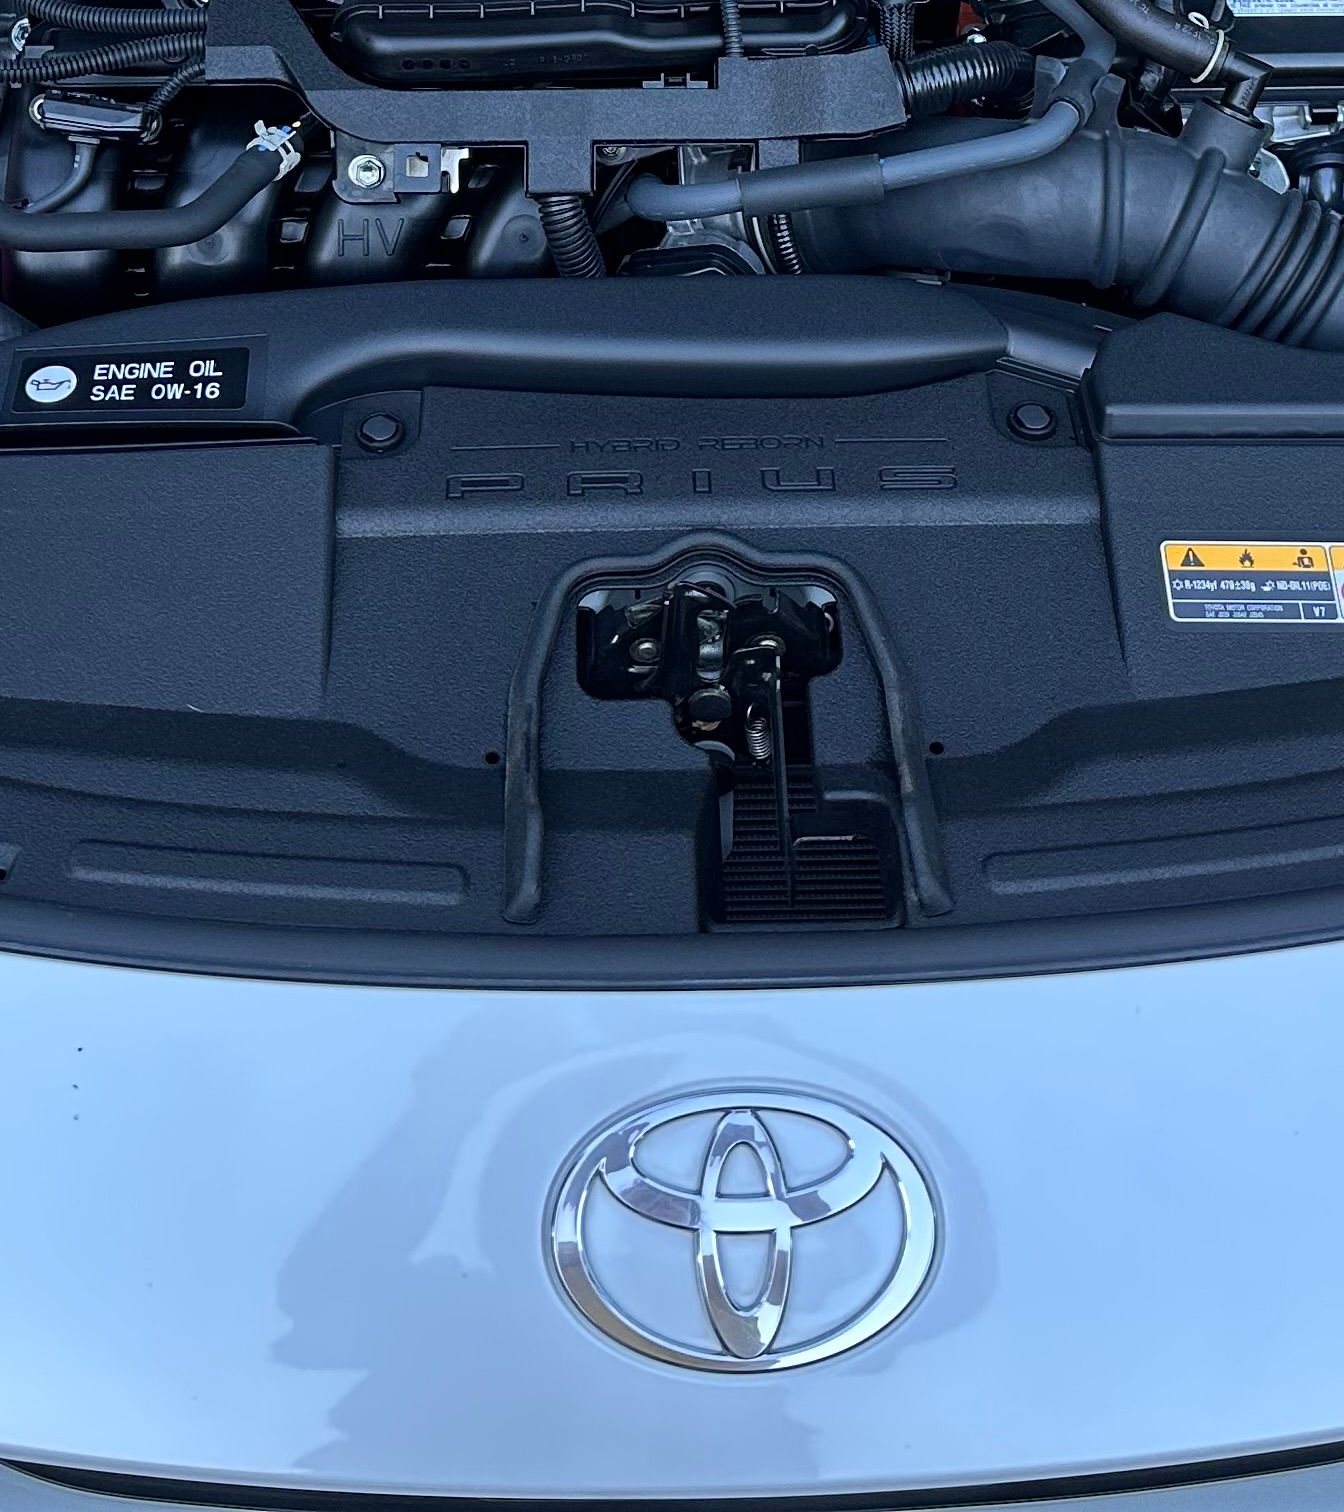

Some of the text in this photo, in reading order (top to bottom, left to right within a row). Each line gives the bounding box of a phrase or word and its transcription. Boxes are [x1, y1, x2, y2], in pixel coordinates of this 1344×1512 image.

[338, 218, 405, 256] HV
[93, 360, 223, 380] ENGINE OIL
[90, 382, 221, 402] SAE 0W-16
[569, 435, 825, 454] HYBRID REBORN
[444, 464, 960, 499] PRIUS
[1312, 606, 1326, 617] V7
